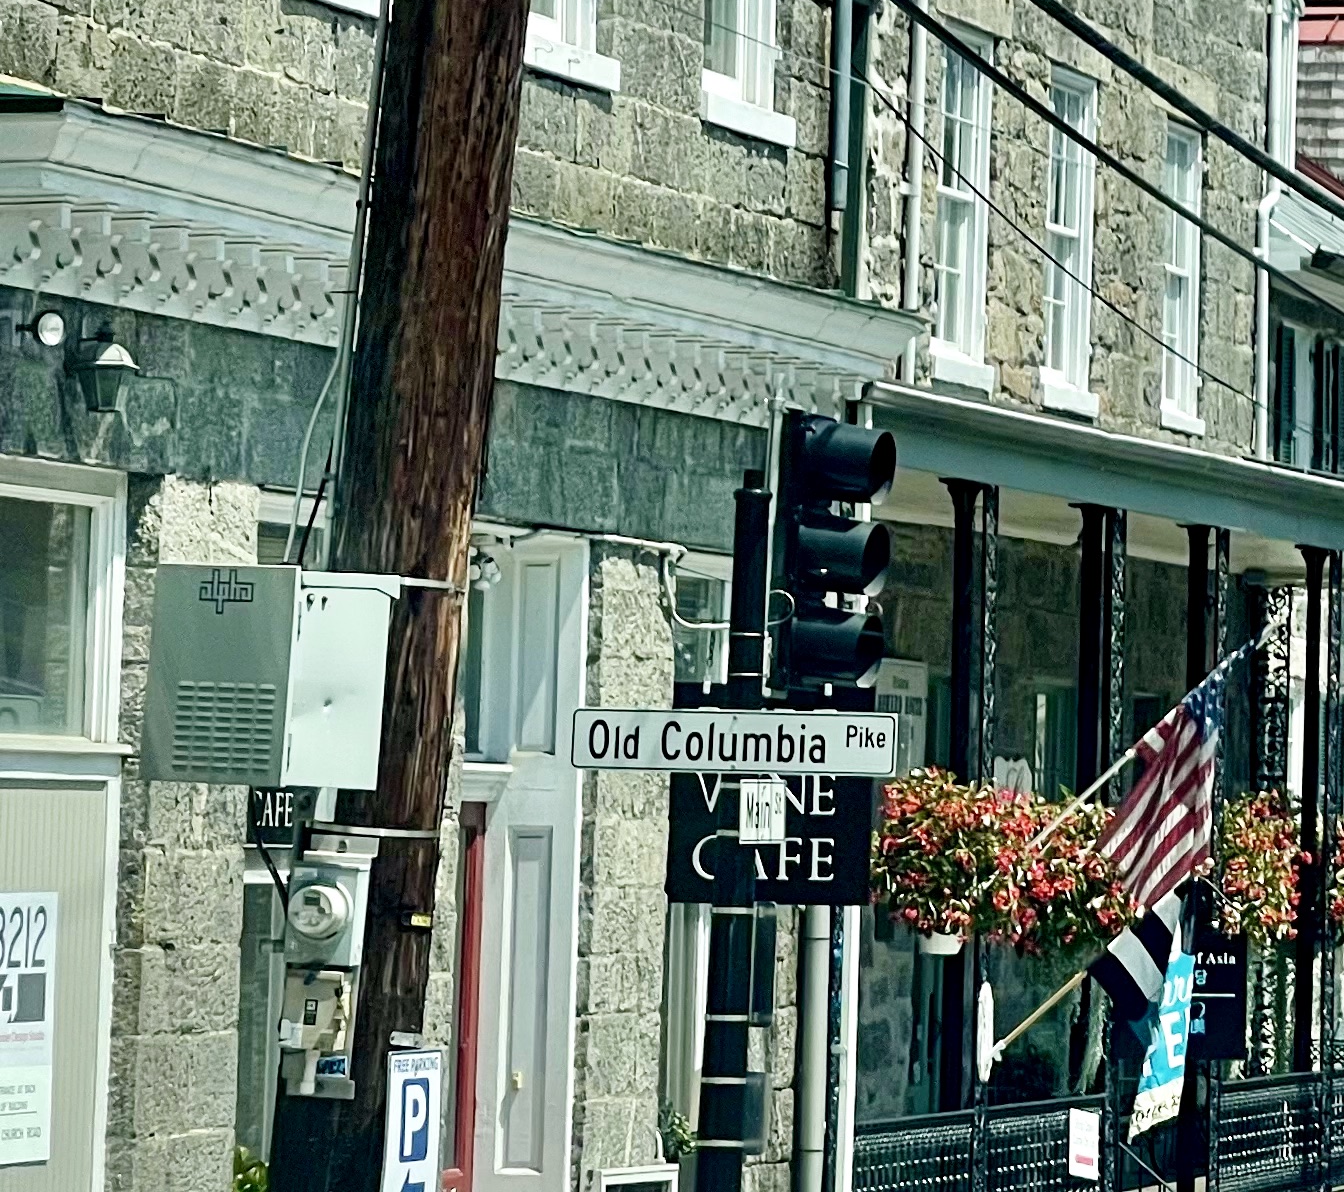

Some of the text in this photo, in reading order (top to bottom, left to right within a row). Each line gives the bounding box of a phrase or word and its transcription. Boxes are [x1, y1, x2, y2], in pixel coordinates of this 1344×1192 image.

[588, 719, 886, 764] Old Columbia Pike
[696, 773, 836, 816] VNE
[746, 791, 770, 829] Main
[1205, 951, 1236, 965] Asia
[393, 1056, 439, 1074] FREE PARKING
[403, 1084, 428, 1157] P
